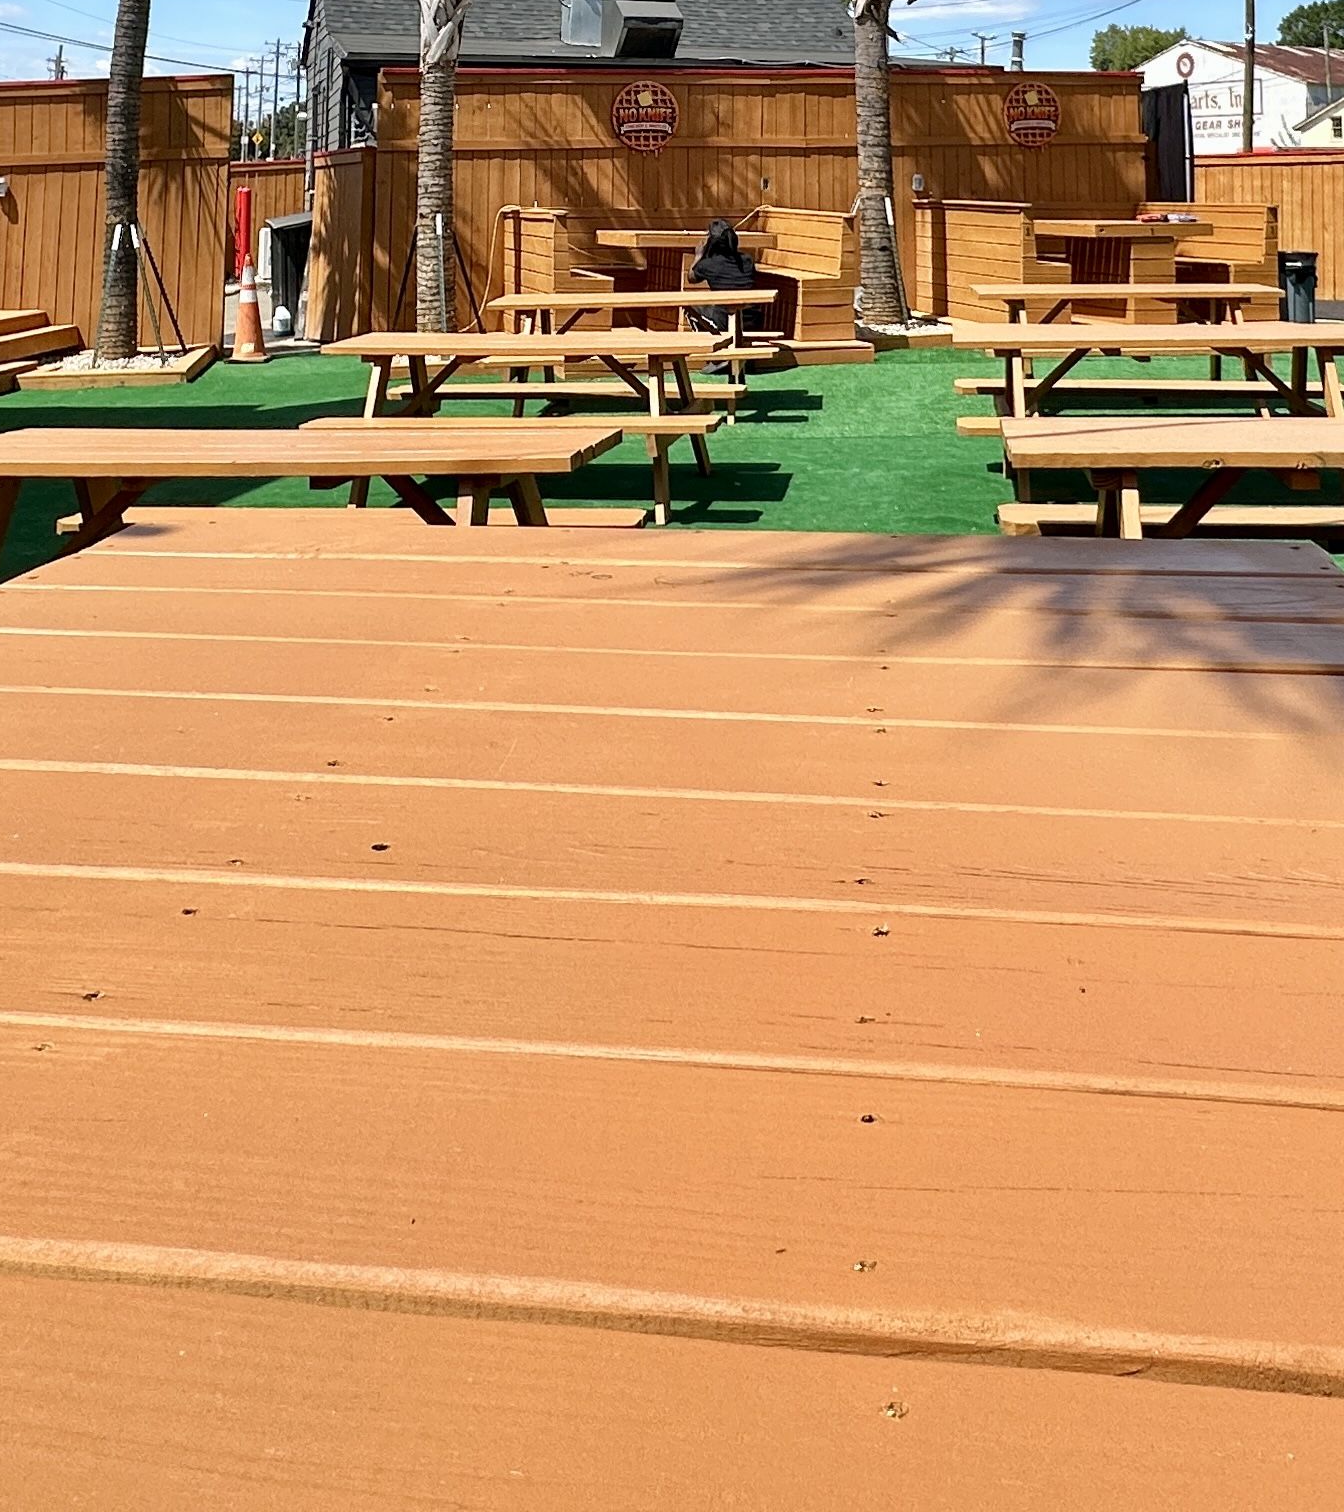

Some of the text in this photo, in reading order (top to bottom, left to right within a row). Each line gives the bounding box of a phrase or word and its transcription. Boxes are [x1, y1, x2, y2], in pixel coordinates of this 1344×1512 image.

[1191, 87, 1244, 110] arts, In
[619, 108, 672, 122] NO KNIFE
[1009, 107, 1056, 120] NO KNIFE
[1196, 121, 1222, 130] GEAR
